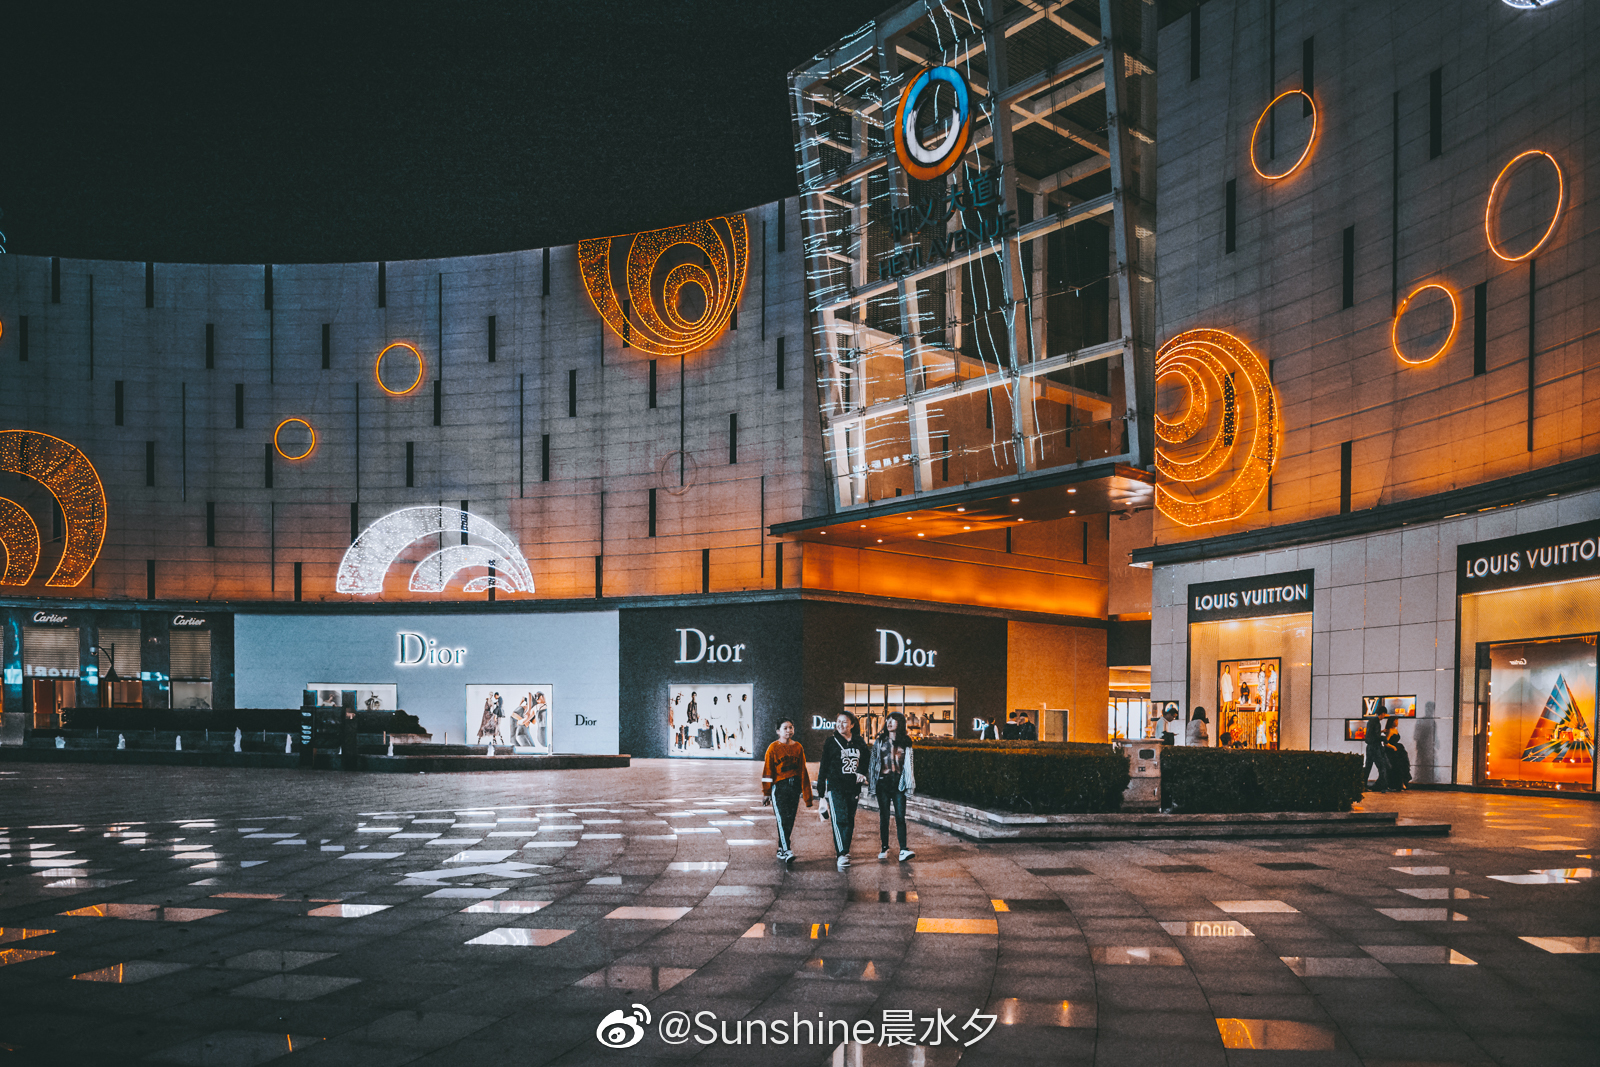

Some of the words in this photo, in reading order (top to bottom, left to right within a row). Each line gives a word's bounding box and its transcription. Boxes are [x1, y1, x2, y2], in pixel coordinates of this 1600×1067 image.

[927, 210, 1017, 263] AVENUE
[1465, 551, 1521, 579] LOUIS
[1195, 590, 1239, 612] LOUIS
[1242, 582, 1308, 606] VUITTON
[33, 611, 67, 623] Cartier
[173, 614, 206, 626] Cartier
[396, 631, 466, 666] Dior
[675, 628, 746, 665] Dior
[875, 628, 938, 668] Dior
[574, 713, 597, 727] Dior
[812, 715, 836, 730] Dior
[841, 757, 860, 774] 23
